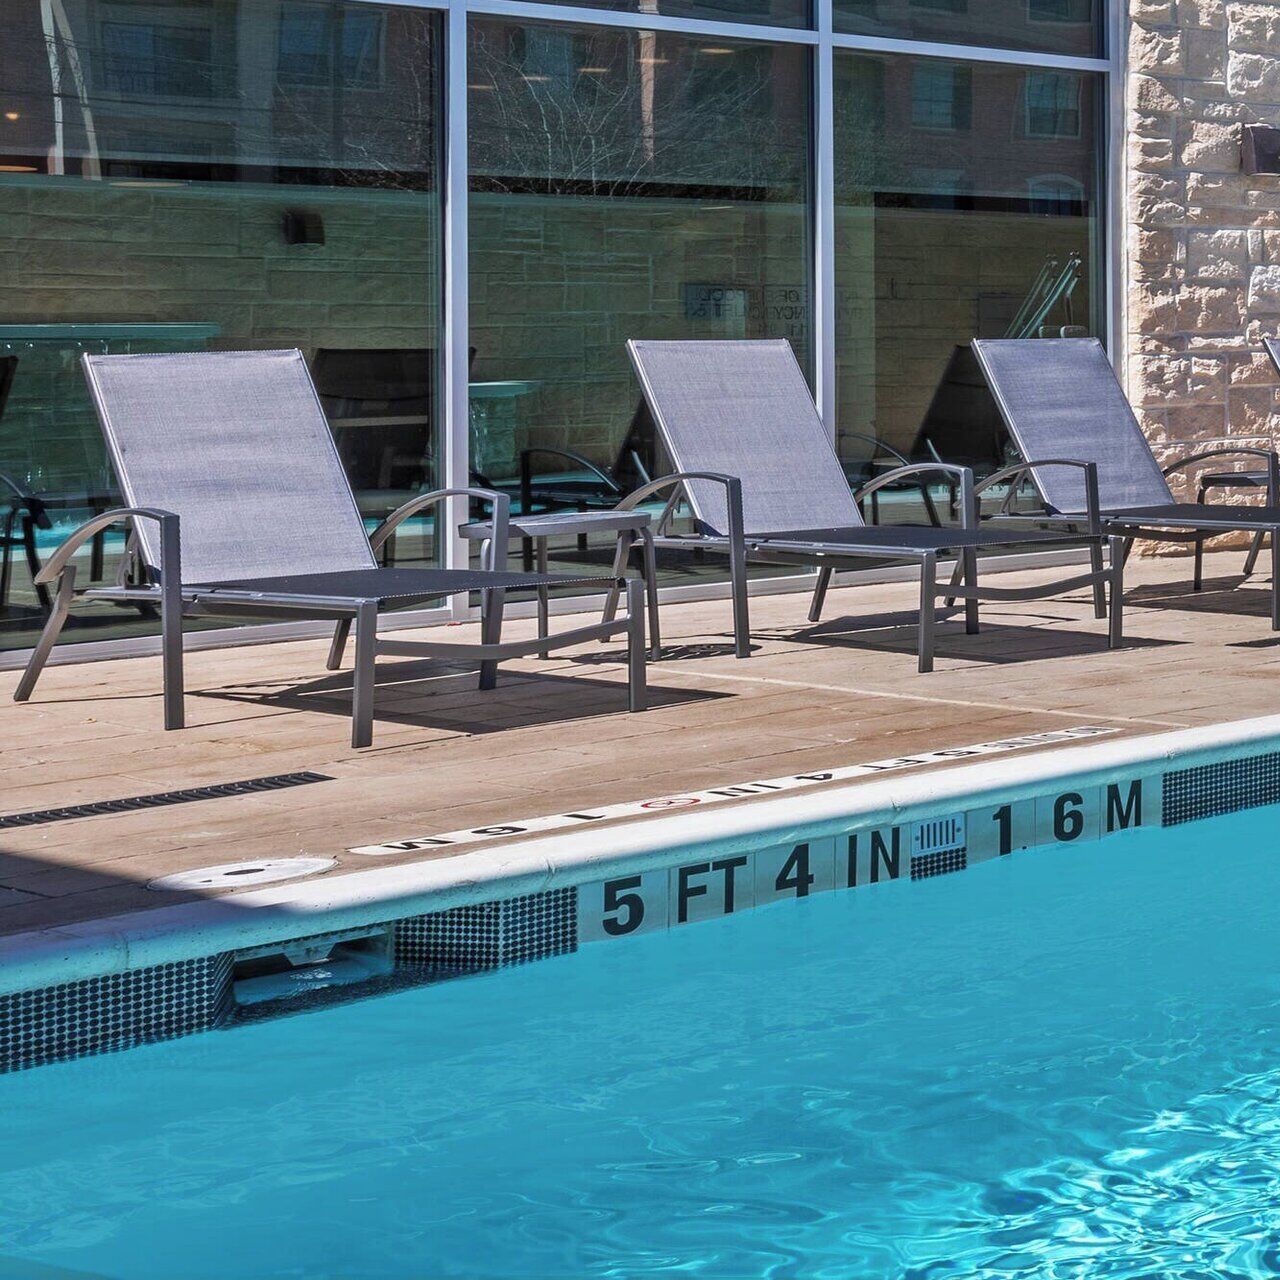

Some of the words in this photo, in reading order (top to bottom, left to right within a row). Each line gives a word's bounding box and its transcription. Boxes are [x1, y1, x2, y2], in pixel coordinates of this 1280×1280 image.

[860, 758, 926, 771] FT
[707, 783, 783, 798] IN
[382, 839, 455, 851] M
[602, 875, 645, 937] 5
[677, 855, 747, 924] FT
[774, 843, 814, 899] 4
[846, 826, 900, 889] IN
[1107, 779, 1142, 833] M
